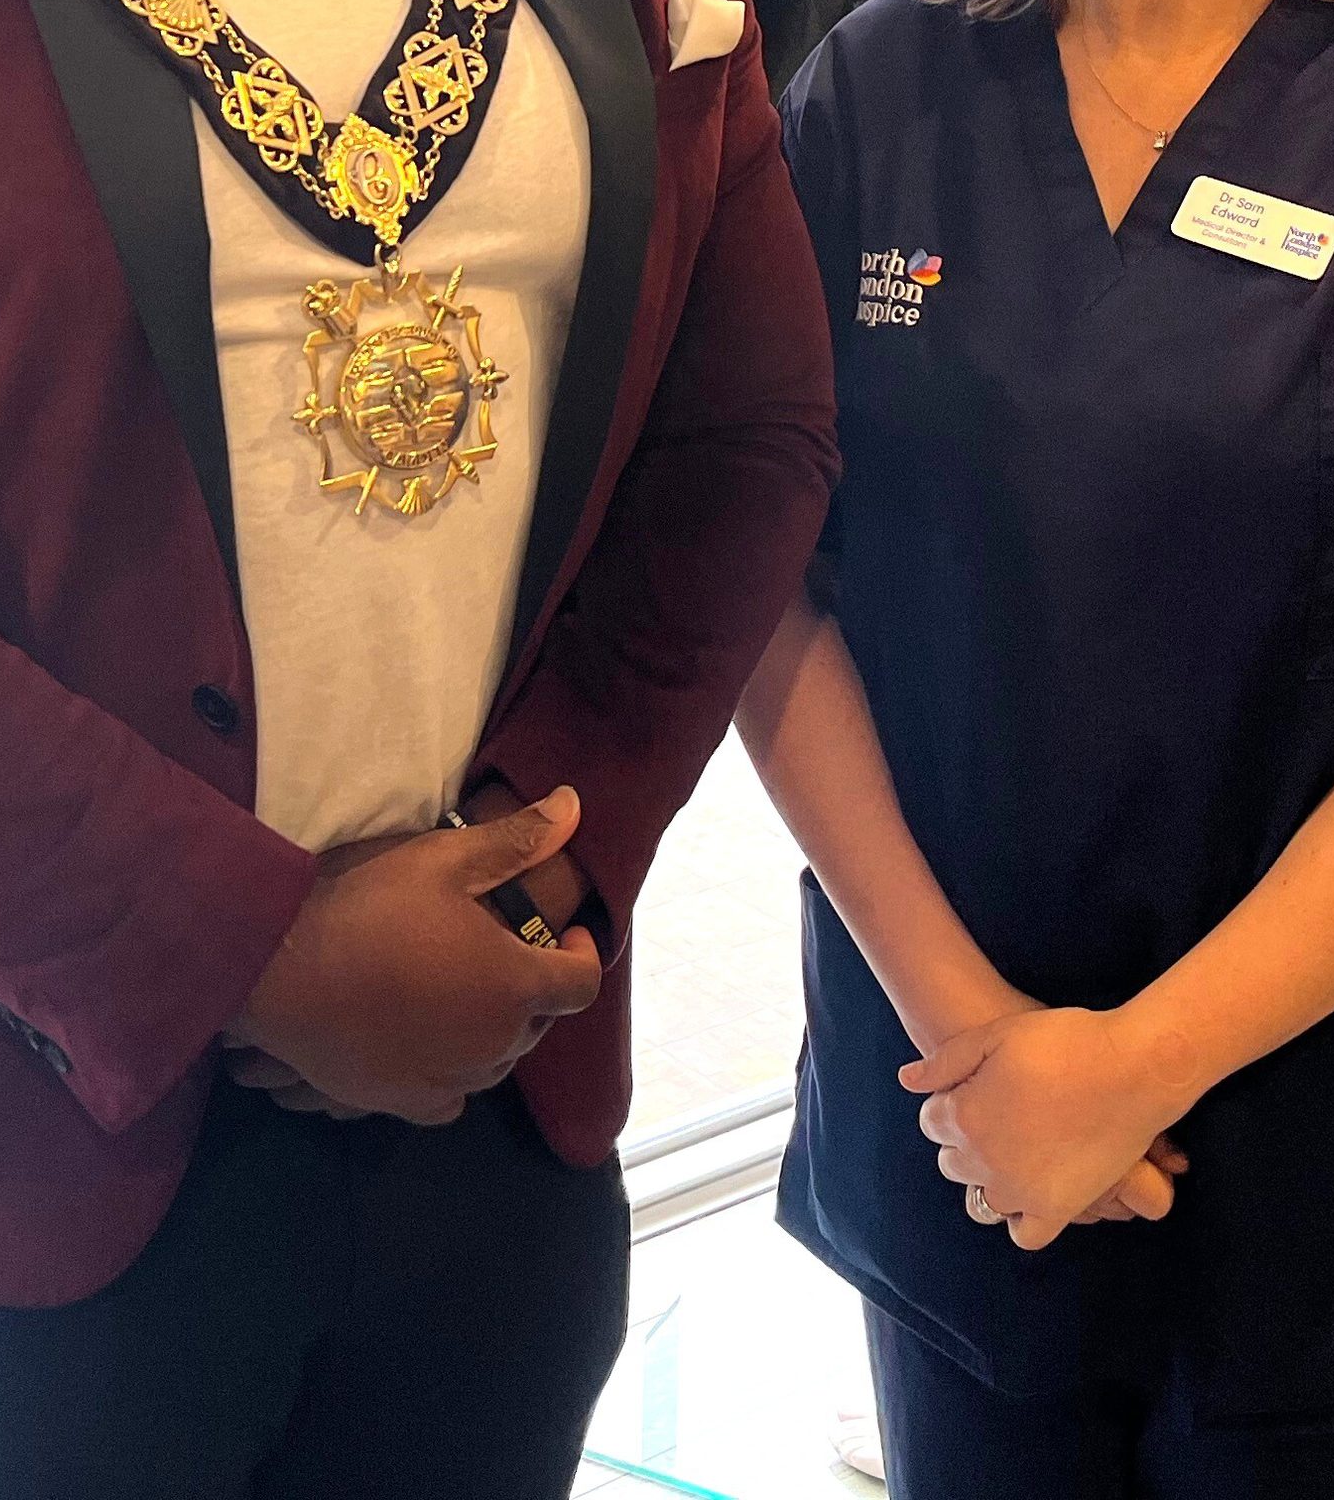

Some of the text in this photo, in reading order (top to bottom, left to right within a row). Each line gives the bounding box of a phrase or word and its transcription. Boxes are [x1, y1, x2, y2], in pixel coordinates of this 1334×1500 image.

[1219, 191, 1265, 215] Dr Sam
[1211, 205, 1260, 228] Edward
[1191, 215, 1266, 246] Medical Director &
[1201, 228, 1248, 250] Consultant
[1289, 226, 1317, 243] North
